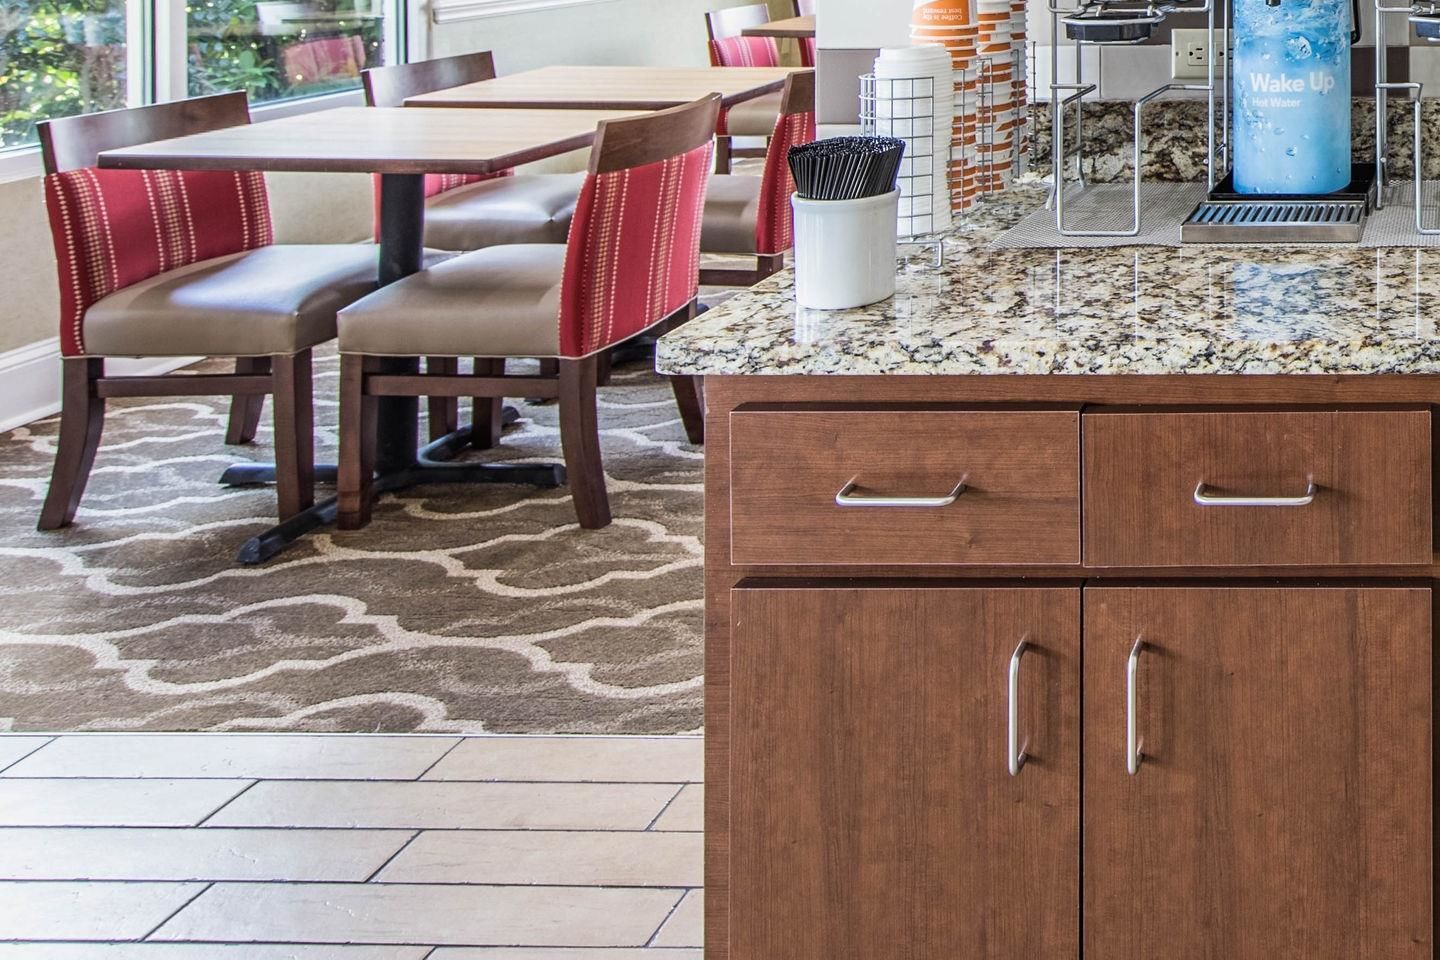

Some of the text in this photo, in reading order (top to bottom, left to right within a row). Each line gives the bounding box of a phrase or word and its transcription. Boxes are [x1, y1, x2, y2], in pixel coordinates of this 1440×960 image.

[1249, 71, 1335, 95] Wake Up
[1252, 97, 1301, 108] Hot Water
